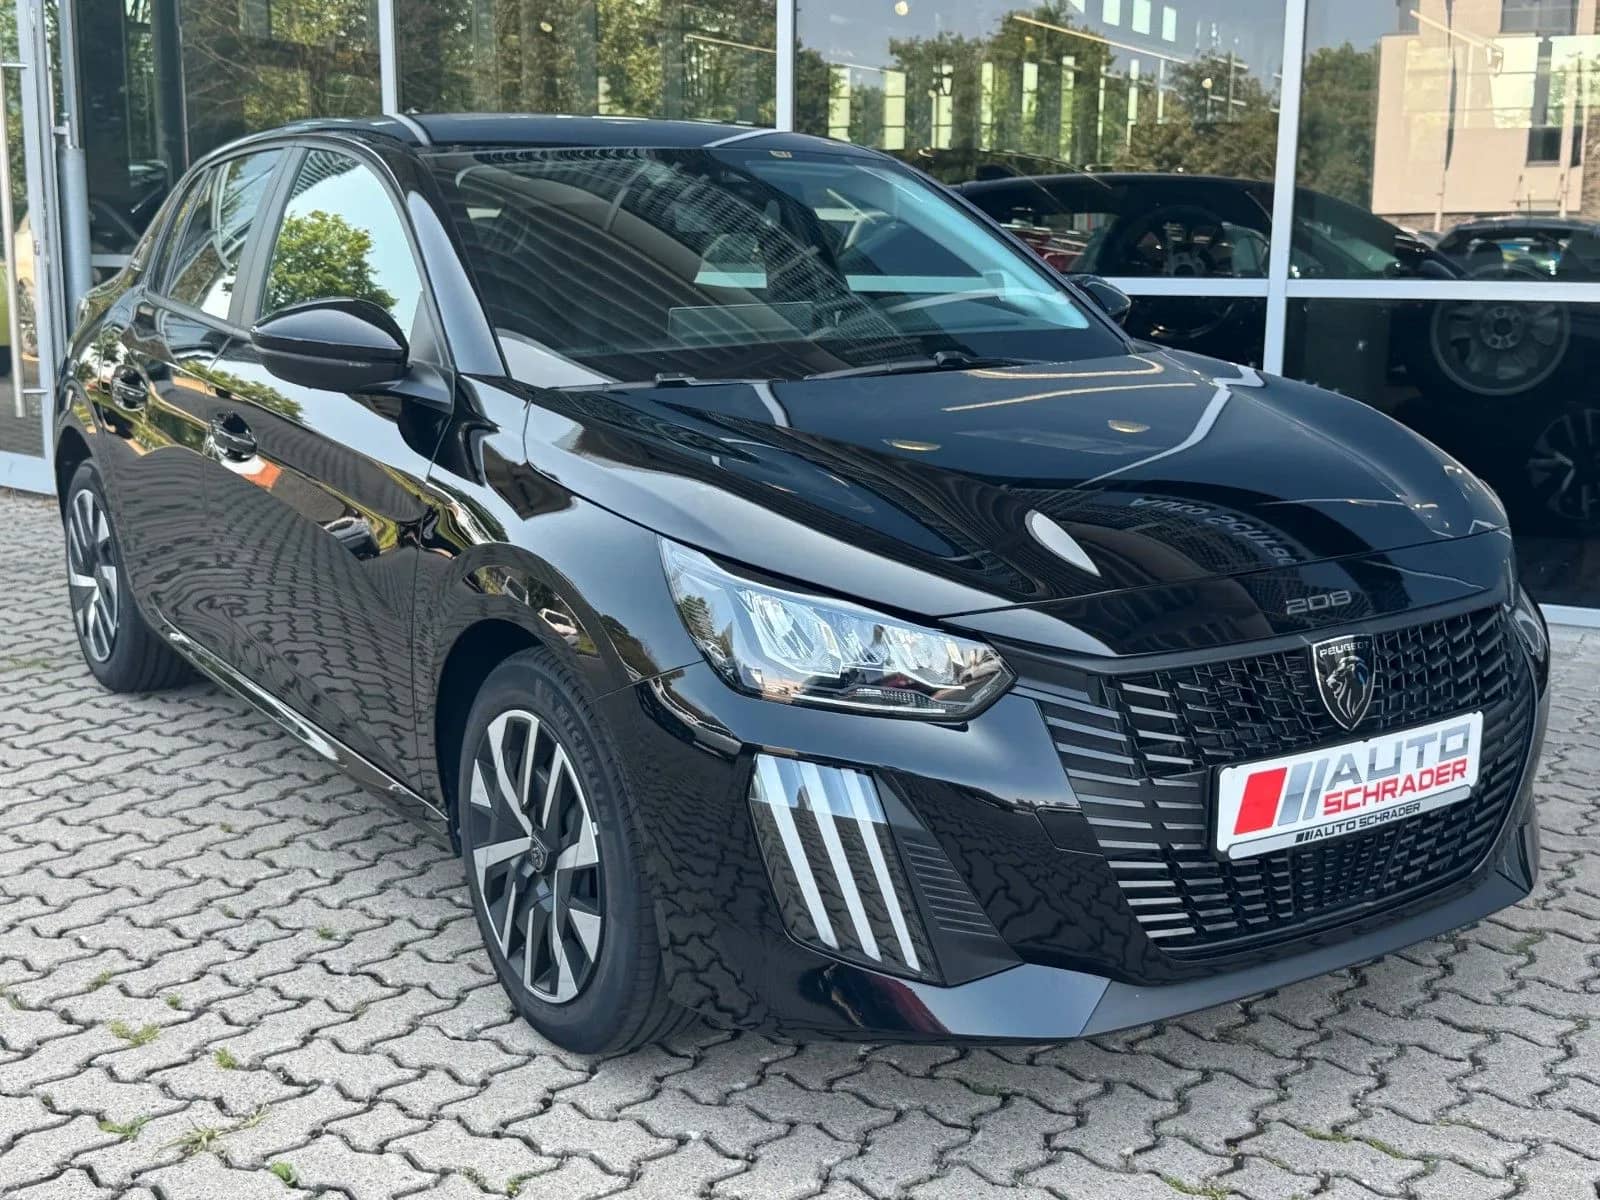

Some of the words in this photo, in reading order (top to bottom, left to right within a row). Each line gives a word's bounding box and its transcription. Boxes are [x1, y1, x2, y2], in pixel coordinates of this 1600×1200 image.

[1286, 590, 1352, 614] 208
[1319, 641, 1369, 657] PEUGEOT
[1326, 723, 1470, 791] AUTO
[1323, 758, 1467, 816] SCHRADER
[1314, 820, 1356, 838] AUTO
[1359, 803, 1421, 828] SCHRADER
